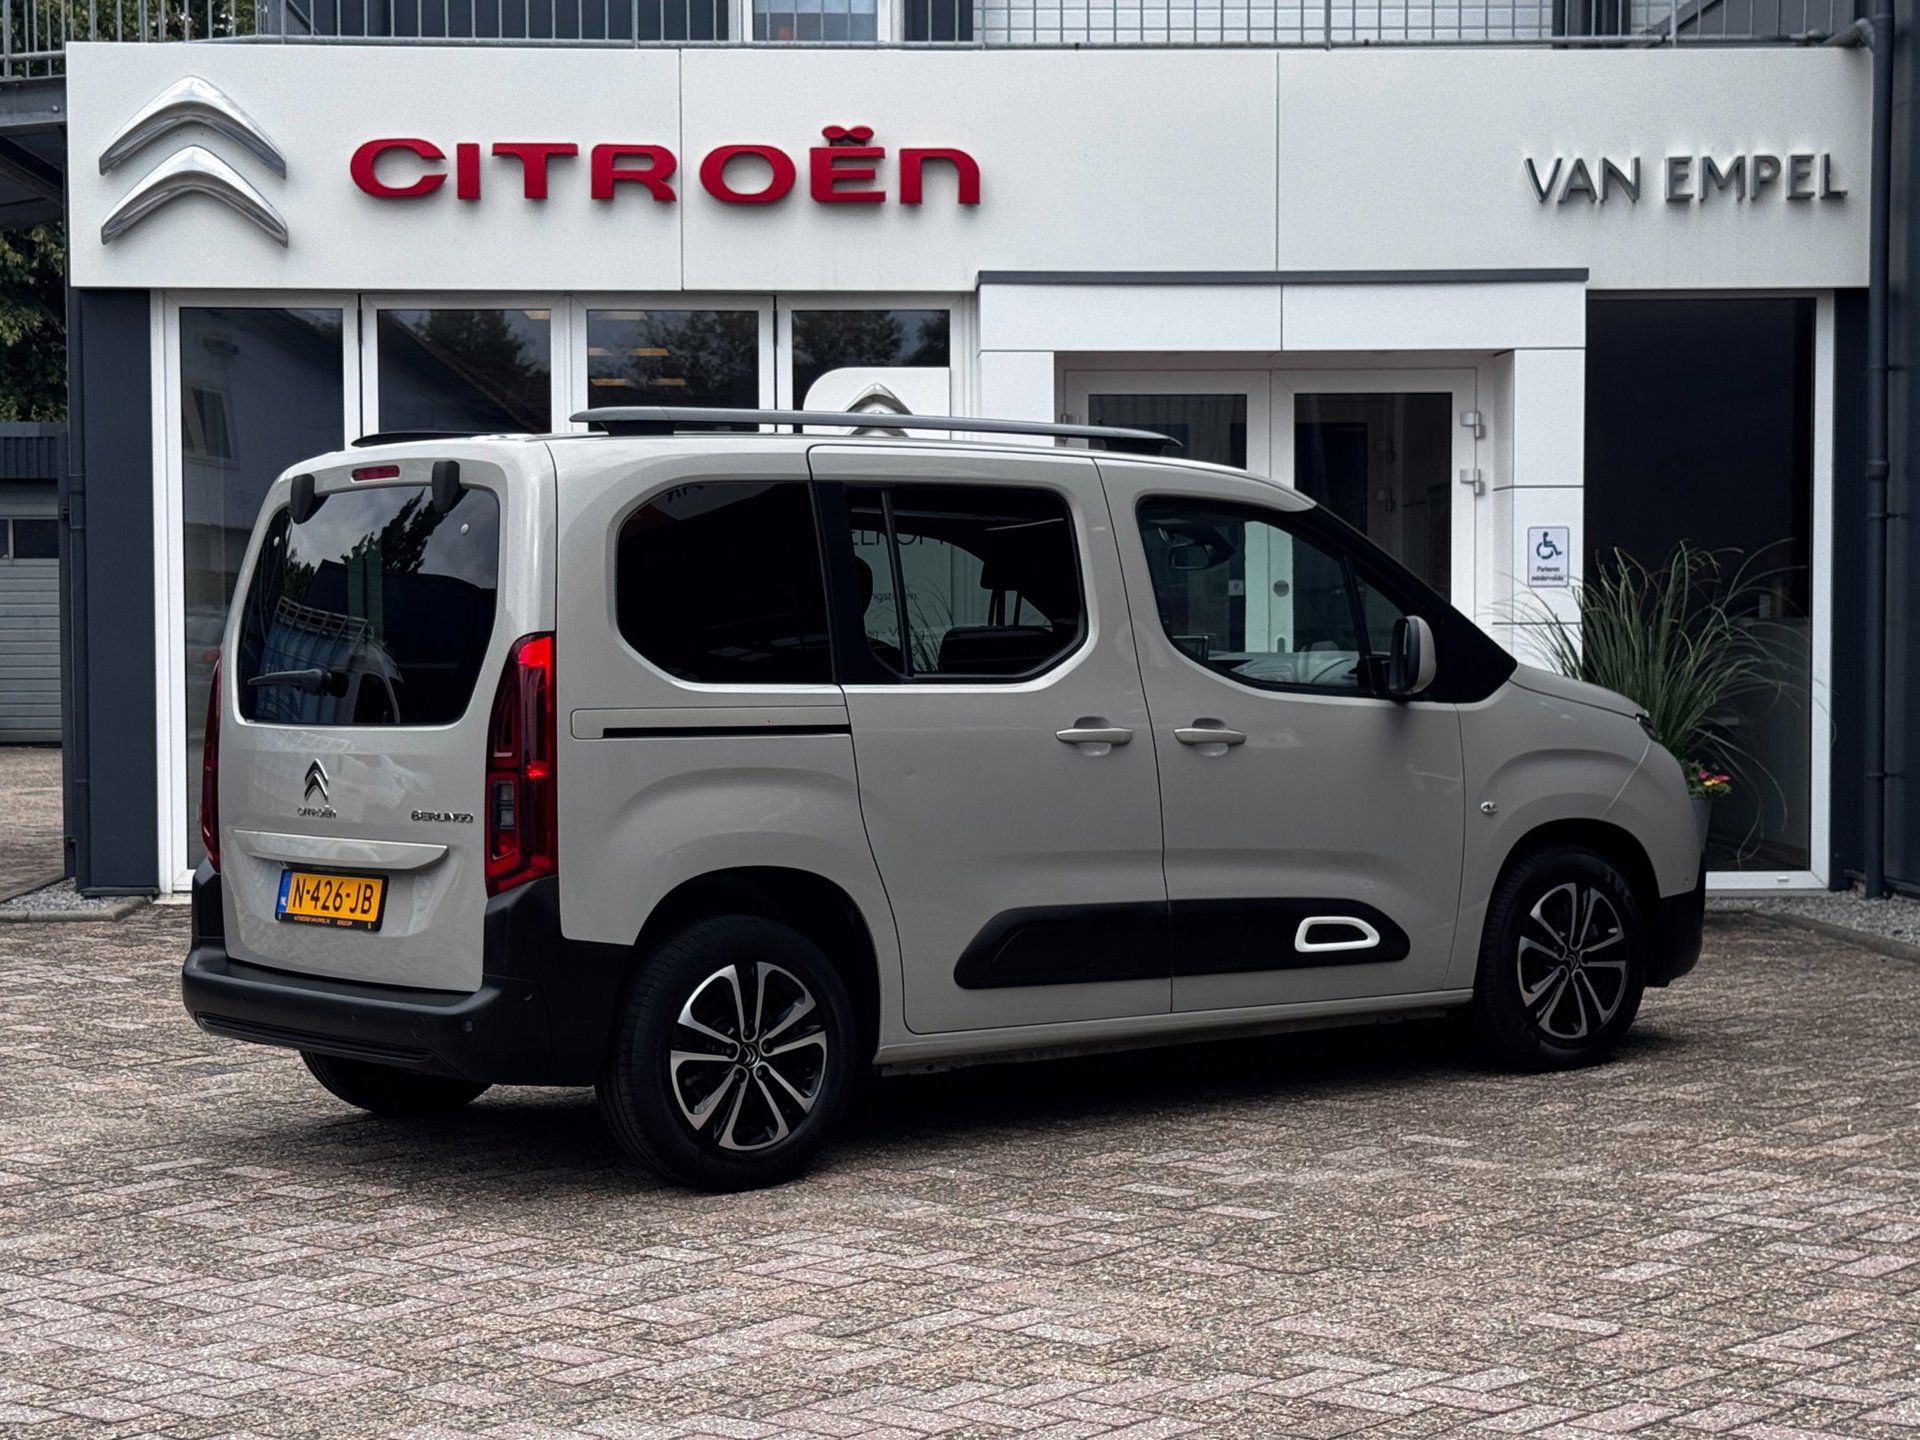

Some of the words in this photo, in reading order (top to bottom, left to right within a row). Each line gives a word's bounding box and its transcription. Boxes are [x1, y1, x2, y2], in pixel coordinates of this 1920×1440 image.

[350, 124, 981, 205] CITROËN
[1523, 156, 1641, 204] VAN
[1663, 152, 1849, 203] EMPEL
[411, 810, 474, 824] BERLINGO
[292, 877, 375, 915] N-426-JB
